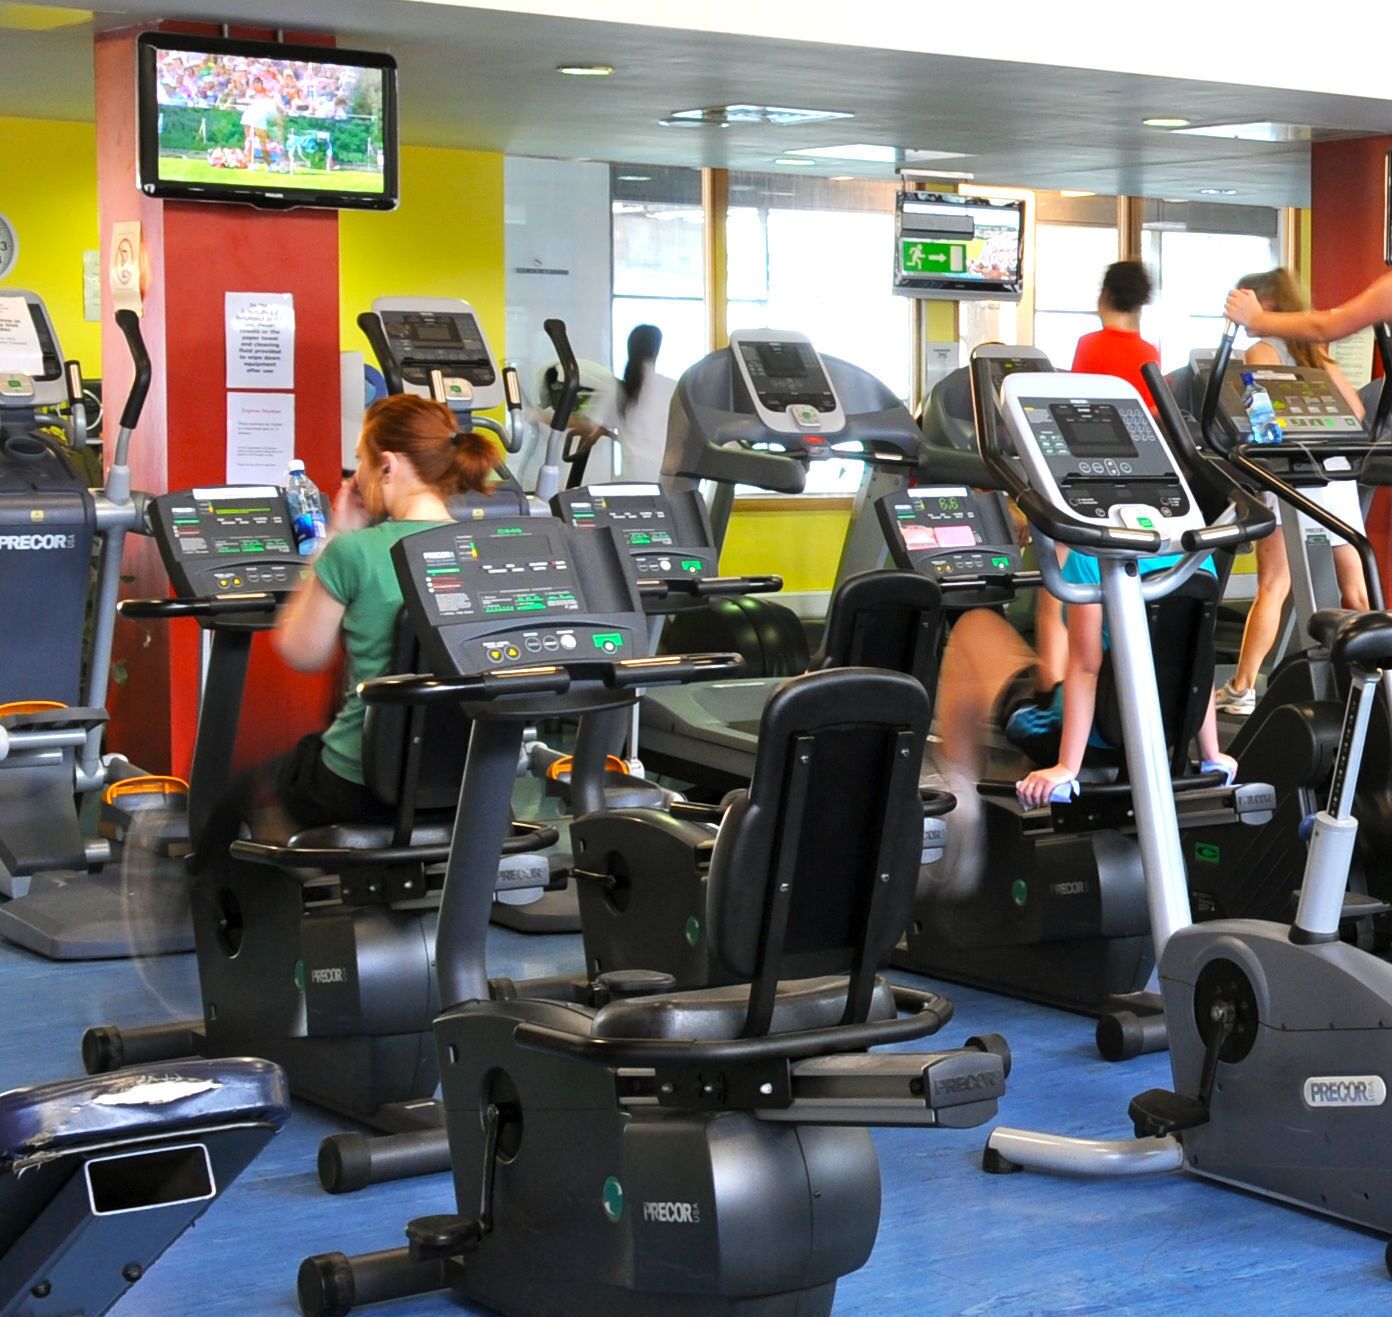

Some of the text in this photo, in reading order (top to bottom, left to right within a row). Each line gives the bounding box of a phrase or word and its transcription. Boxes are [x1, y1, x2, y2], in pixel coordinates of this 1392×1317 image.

[0, 534, 67, 550] PRECOR
[312, 968, 343, 983] PRECOR
[1311, 1081, 1368, 1103] PRECOR
[643, 1202, 692, 1223] PRECOR
